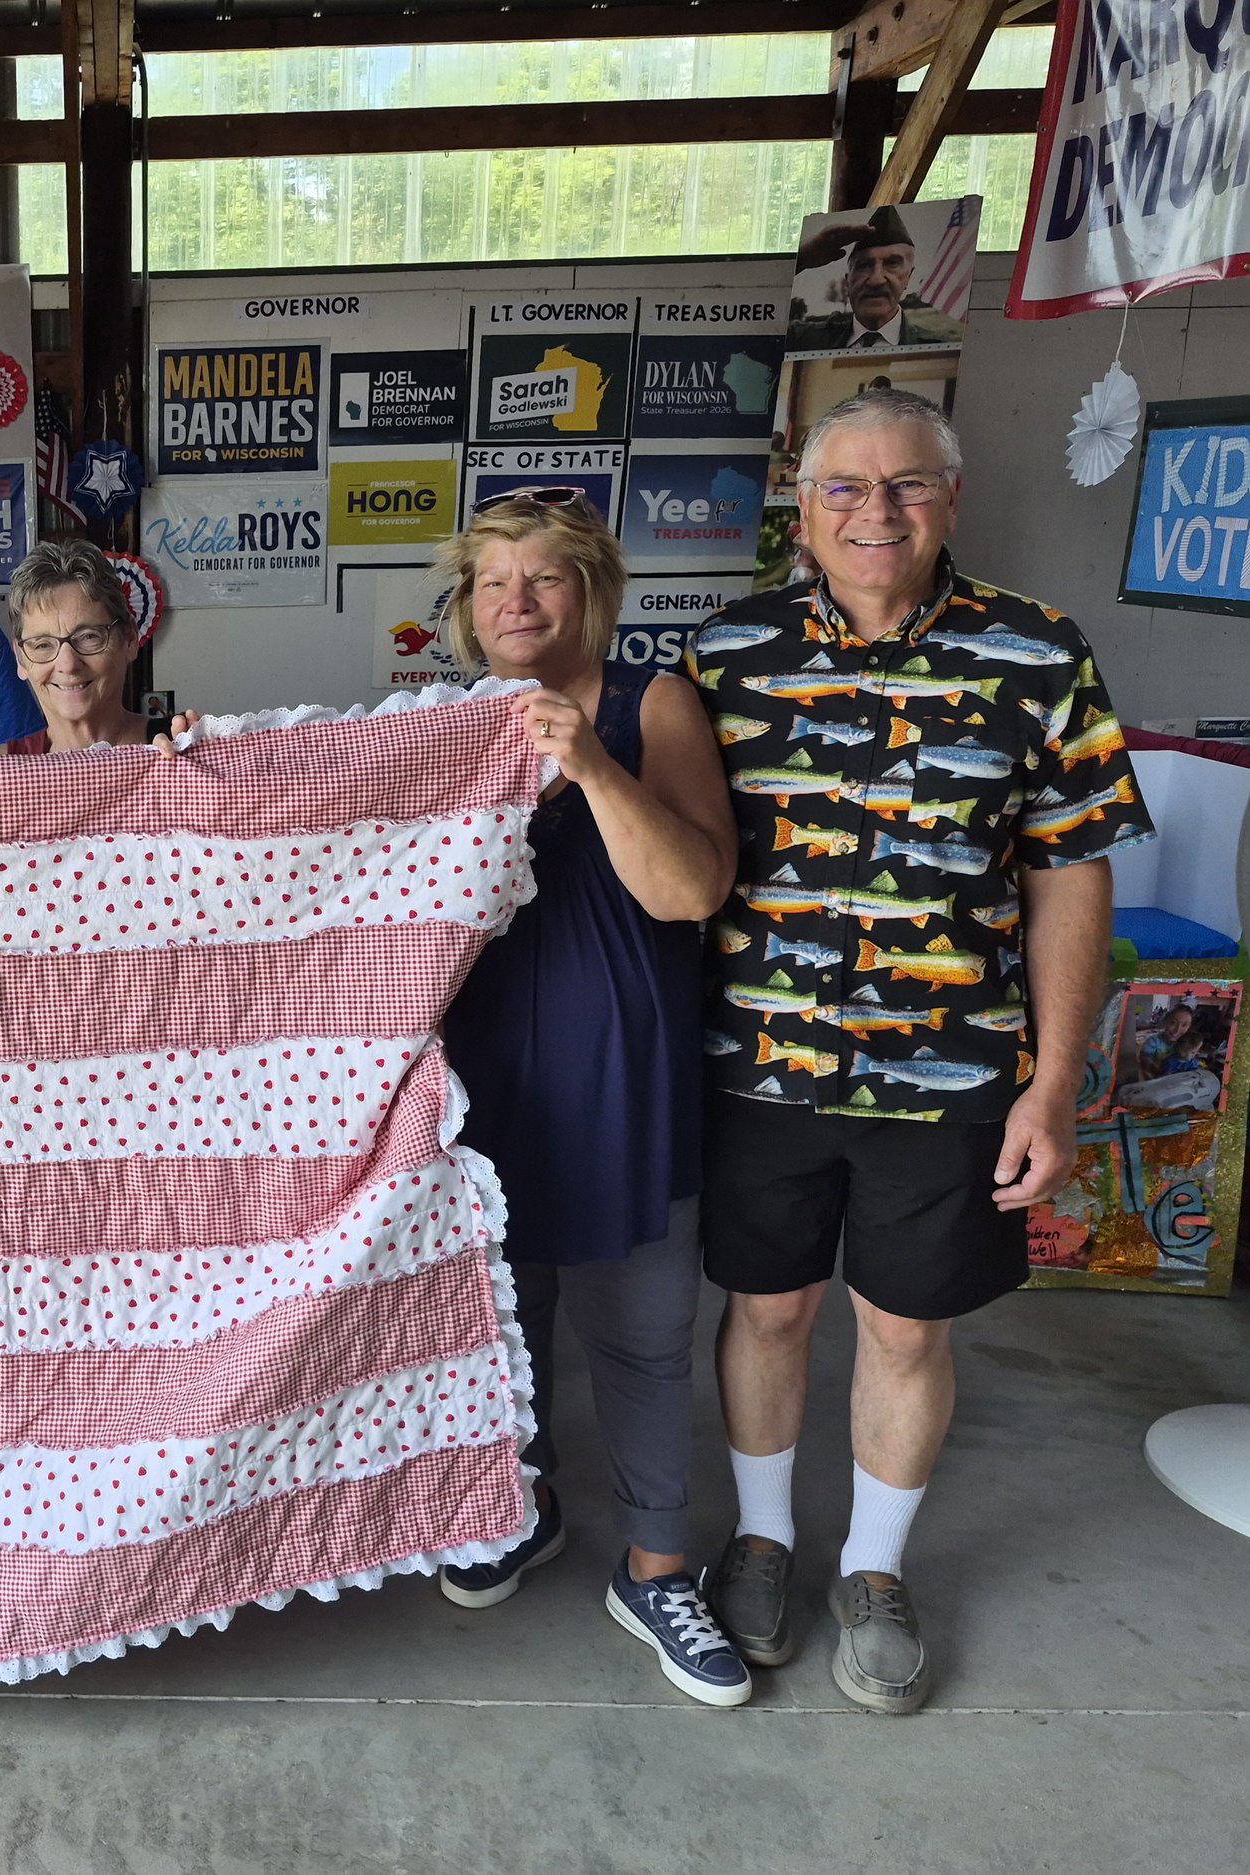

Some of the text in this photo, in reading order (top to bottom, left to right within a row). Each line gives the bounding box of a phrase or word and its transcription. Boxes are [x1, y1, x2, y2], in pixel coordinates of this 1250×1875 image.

[245, 296, 360, 318] GOVERNOR
[490, 303, 629, 322] LT. GOVERNOR
[654, 303, 776, 322] TREASURER
[163, 351, 314, 400] MANDELA
[373, 370, 417, 387] JOEL
[644, 361, 718, 388] DYLAN
[372, 386, 456, 403] BRENNAN
[499, 375, 569, 401] Sarah
[498, 395, 567, 415] Godlewski
[642, 390, 729, 404] FOR WISCONSIN
[371, 404, 430, 415] DEMOCRAT
[641, 405, 732, 414] State Treasurer 2026
[163, 399, 314, 446] BARNES
[371, 415, 454, 427] FOR GOVERNOR
[488, 417, 549, 432] FOR WISCONSIN
[172, 447, 305, 461] FOR WISCONSIN
[466, 450, 623, 468] SEC OF STATE
[369, 480, 416, 488] FRANCESCA
[347, 488, 437, 513] HONG
[639, 488, 710, 523] Yee
[361, 517, 421, 526] FOR GOVERNOR
[145, 510, 321, 571] Kelda ROYS
[653, 528, 742, 540] TREASURER
[193, 555, 321, 572] DEMOCRAT FOR GOVERNOR
[640, 593, 723, 611] GENERAL
[391, 671, 437, 683] EVERY
